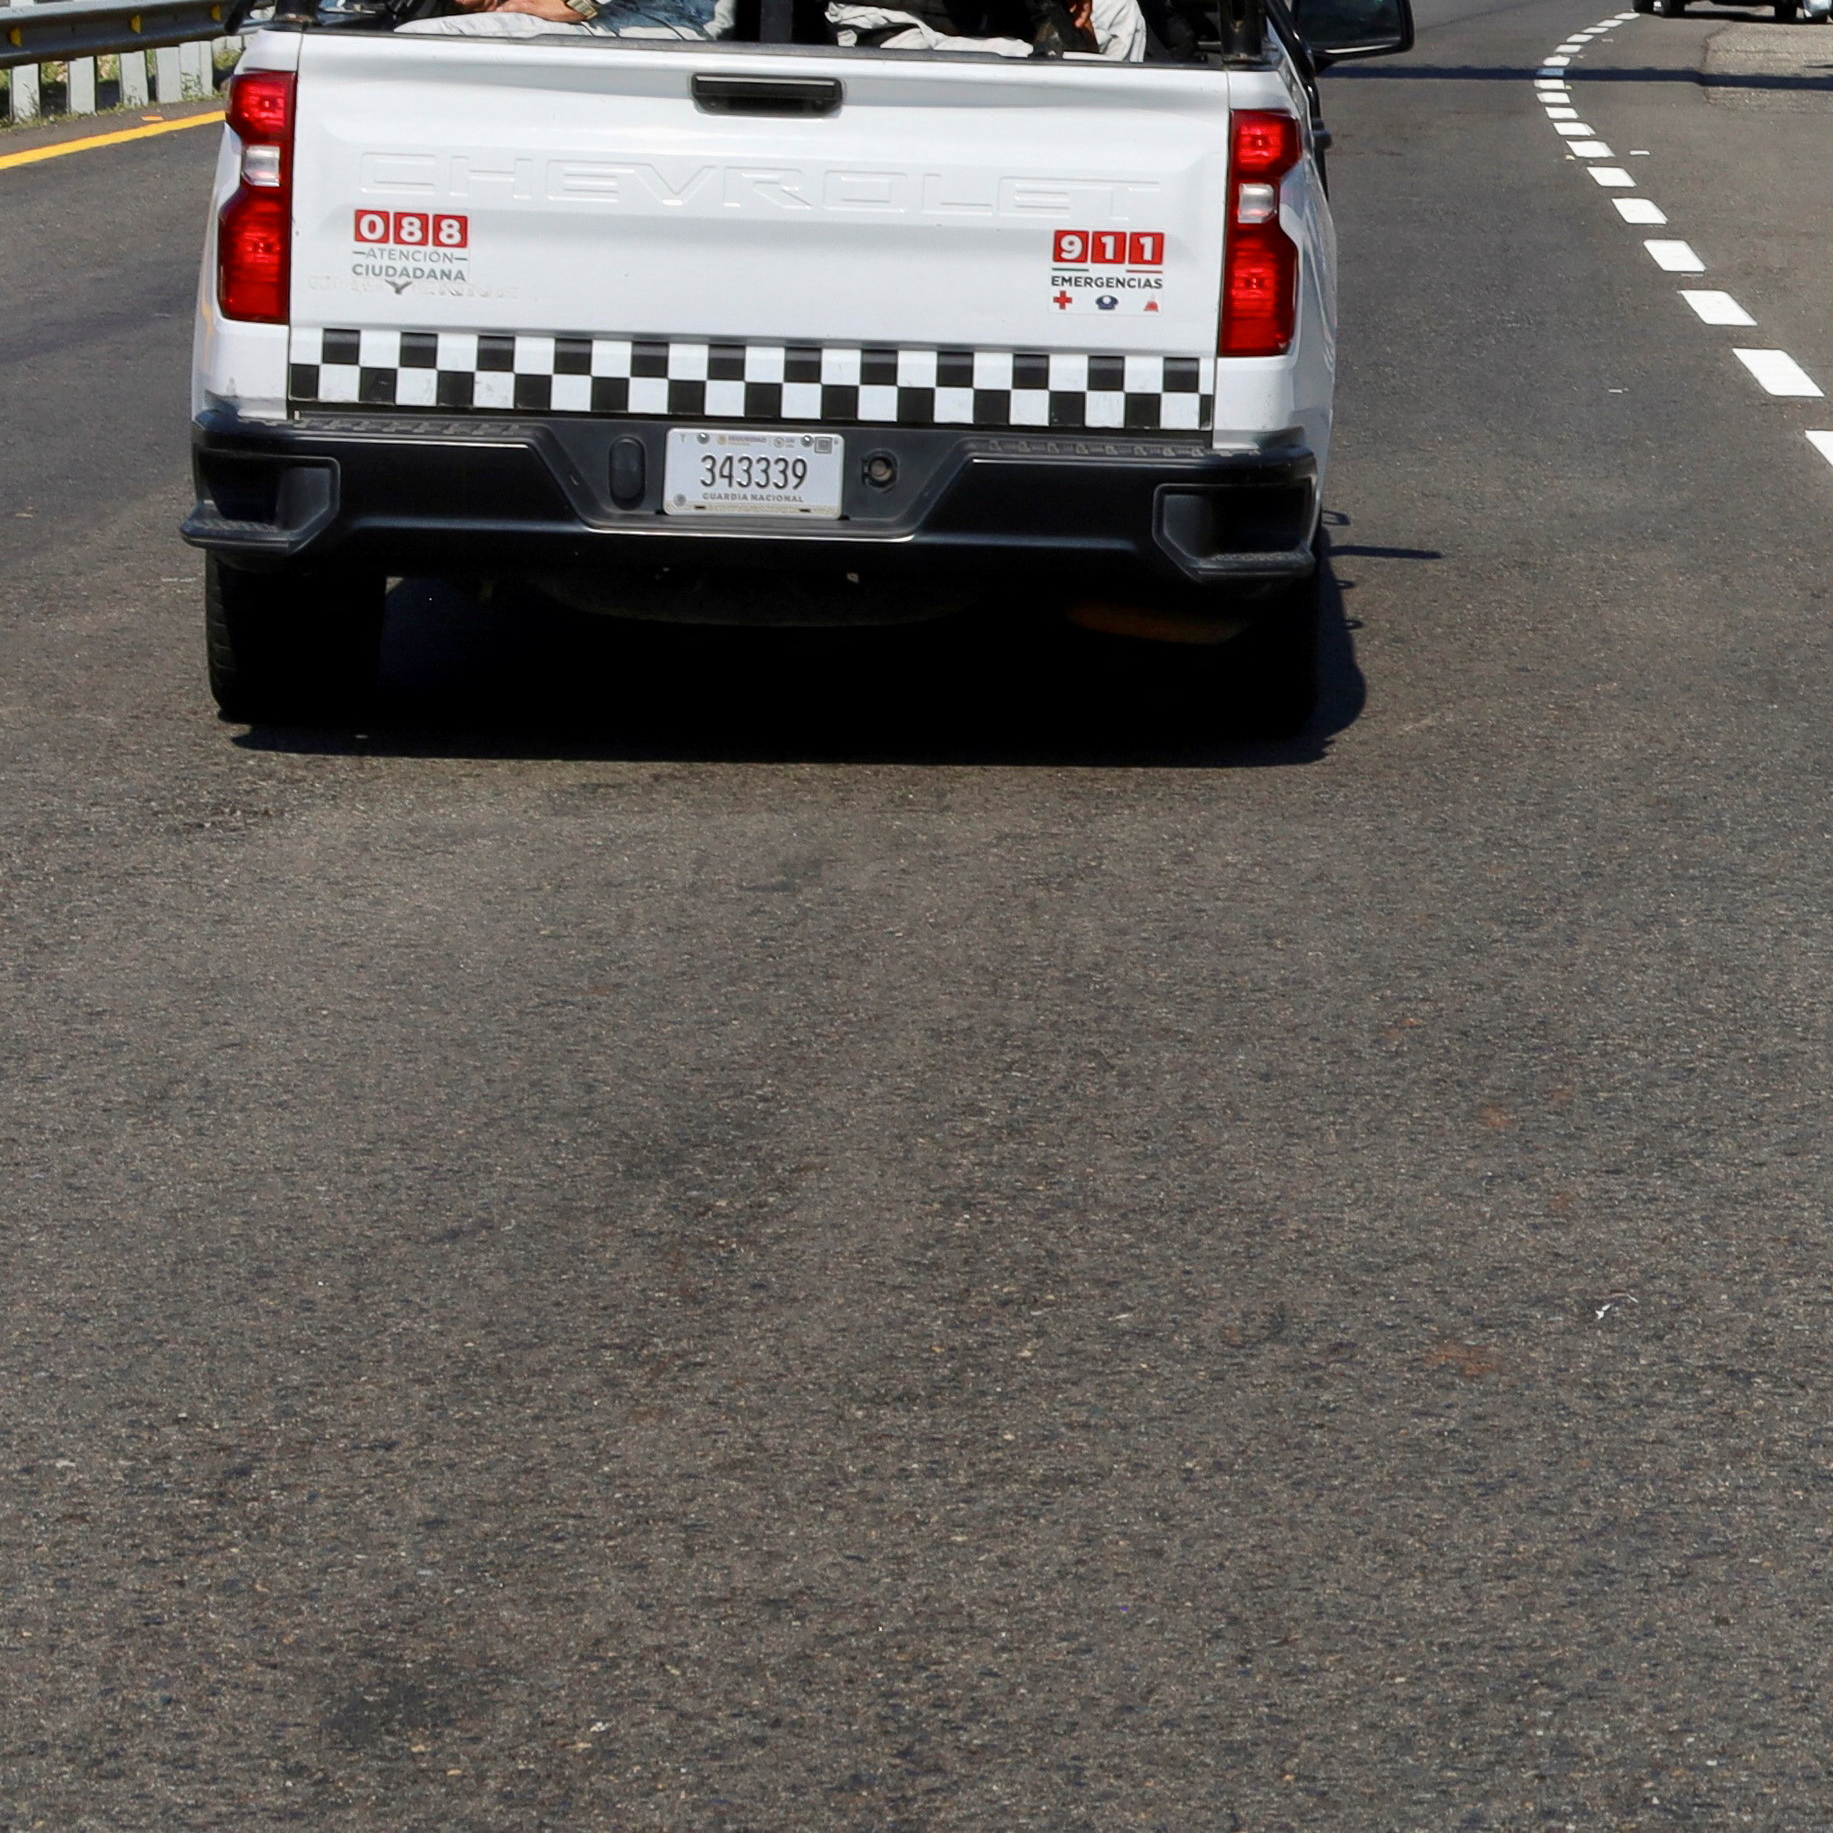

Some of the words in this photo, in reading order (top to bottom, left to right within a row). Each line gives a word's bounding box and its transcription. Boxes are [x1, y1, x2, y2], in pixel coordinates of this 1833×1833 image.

[359, 152, 1161, 222] CHEVROLET
[358, 212, 464, 247] 088
[365, 246, 454, 263] ATENCIÓN
[1059, 233, 1157, 262] 911
[351, 263, 466, 282] CIUDADANA
[1051, 275, 1163, 289] EMERGENCIAS
[700, 454, 807, 490] 343339
[702, 492, 748, 502] GUARDIA
[750, 493, 804, 503] NACIONAL
